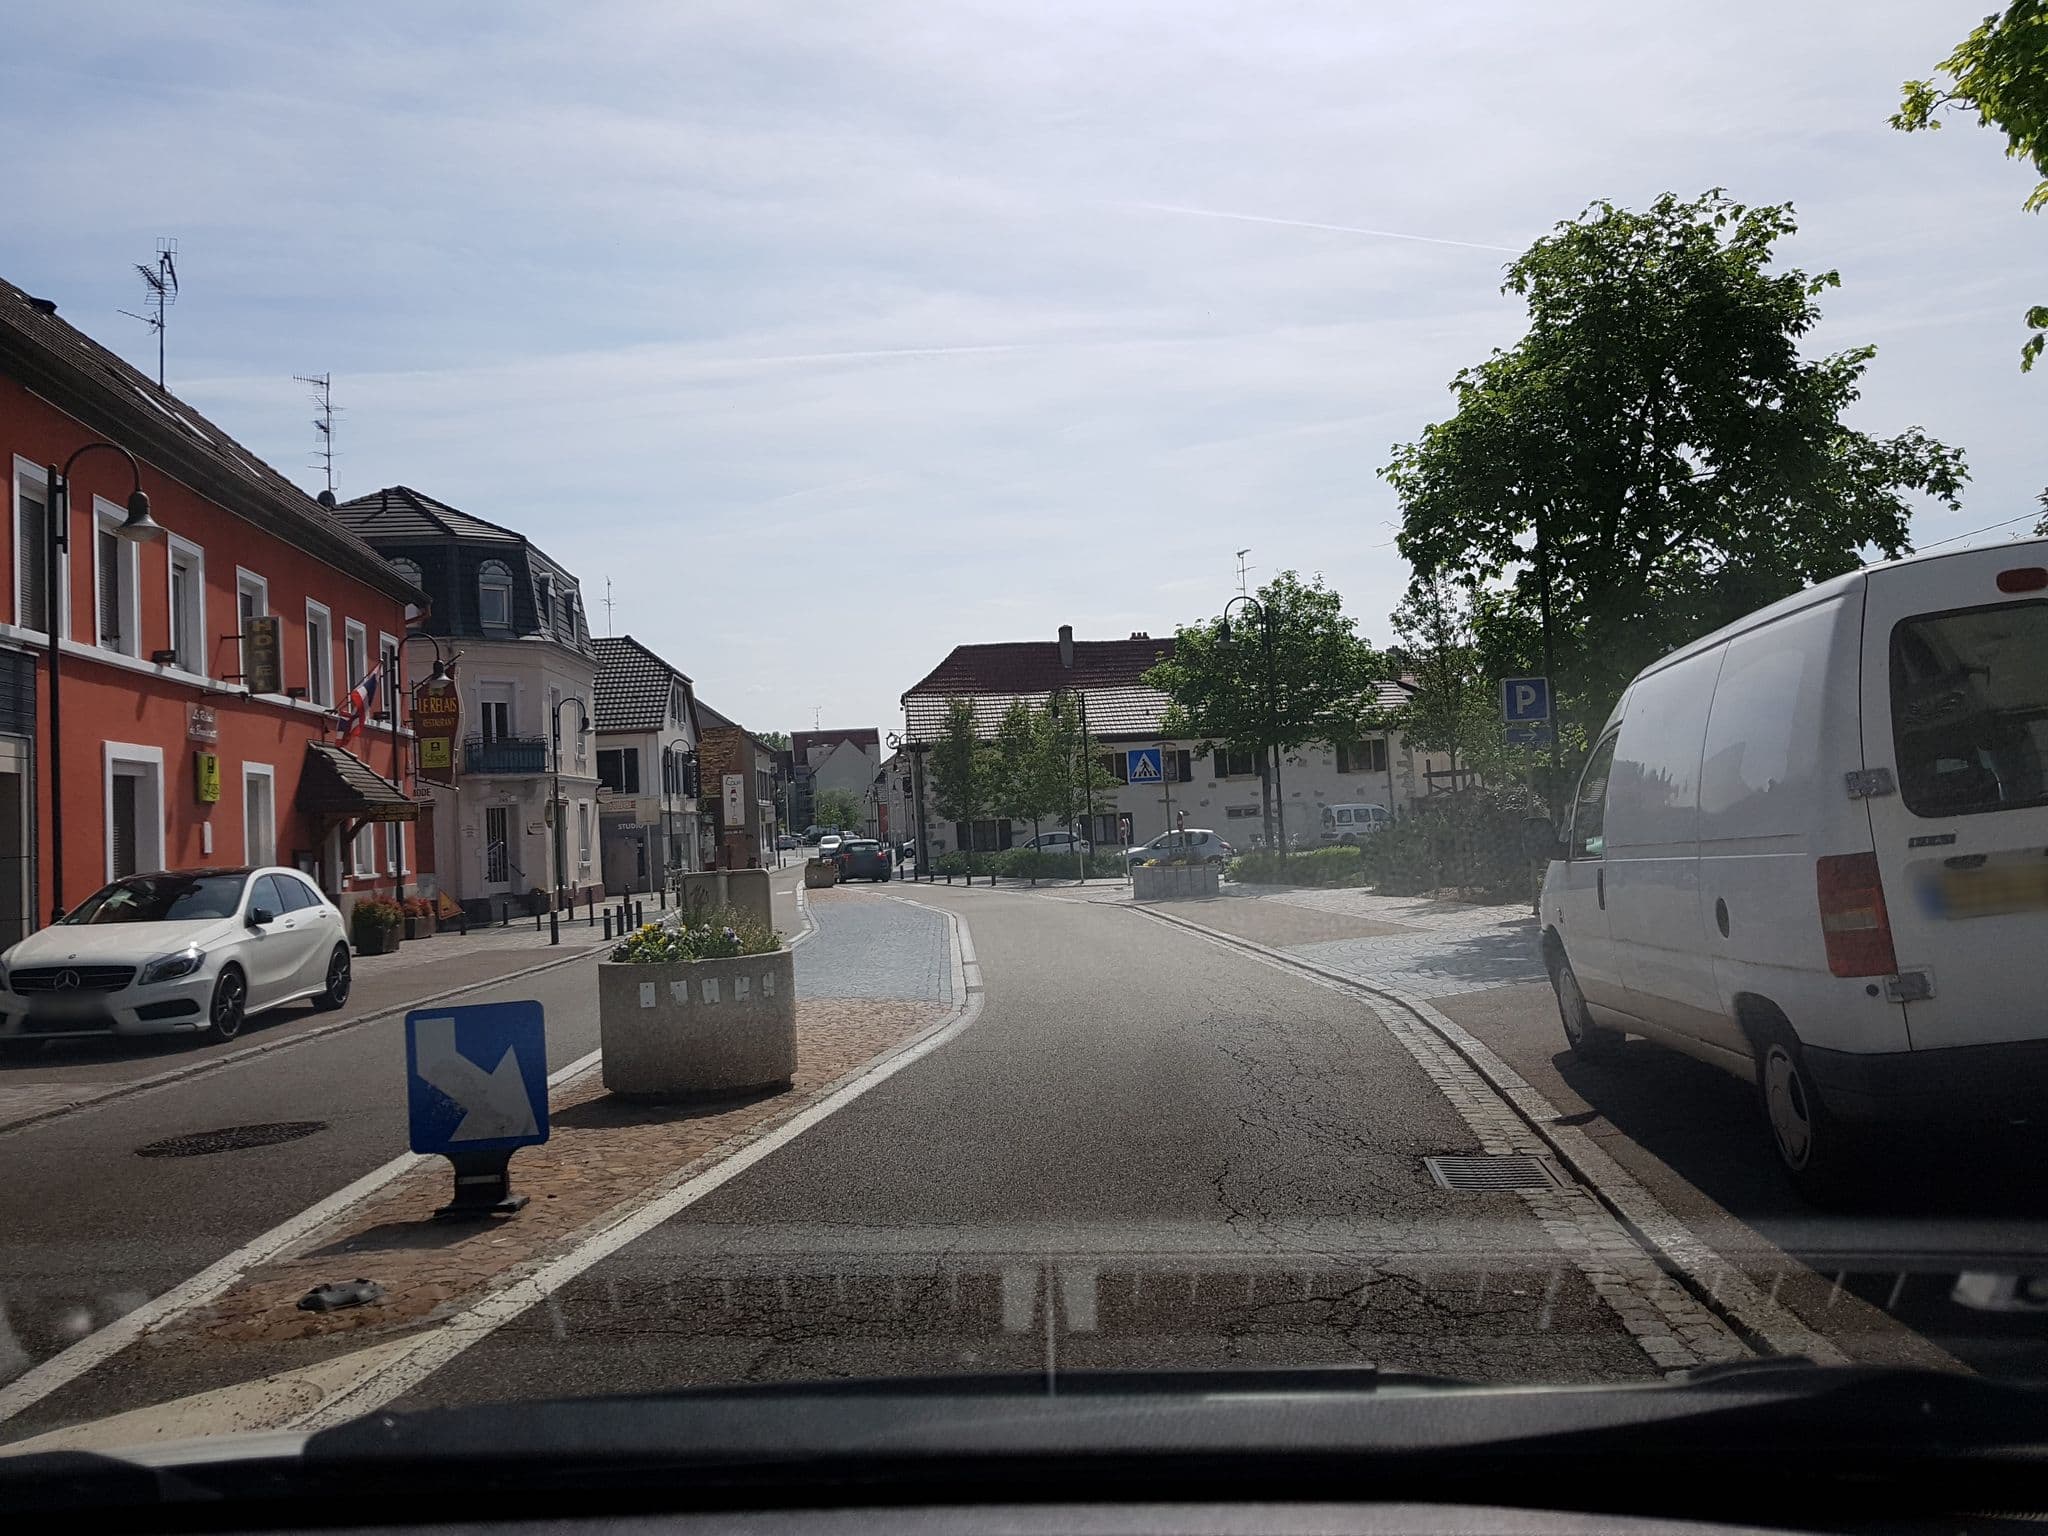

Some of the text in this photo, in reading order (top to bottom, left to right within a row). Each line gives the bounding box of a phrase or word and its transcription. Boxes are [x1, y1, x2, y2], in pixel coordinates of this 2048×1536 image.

[254, 620, 273, 691] HOTEL
[418, 697, 457, 714] LE RELAIS
[1516, 685, 1536, 714] P
[422, 718, 455, 728] RESTAURANT
